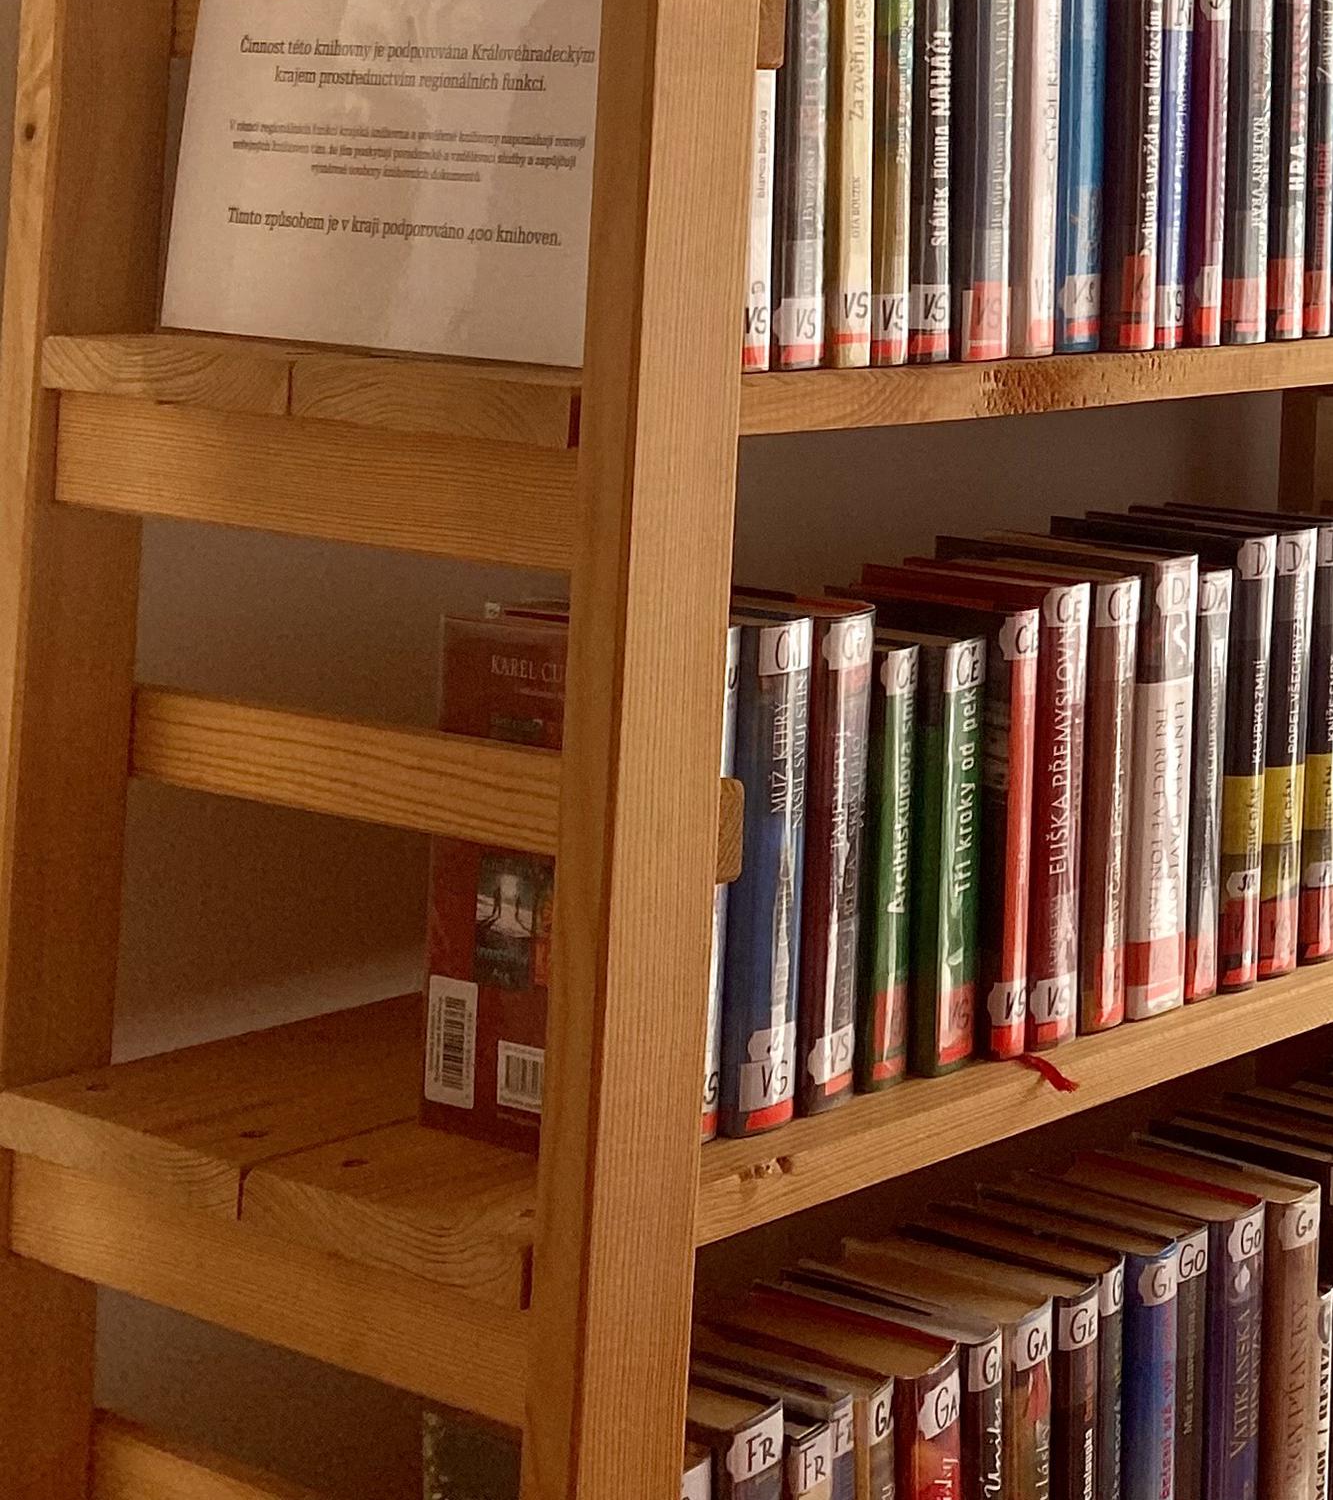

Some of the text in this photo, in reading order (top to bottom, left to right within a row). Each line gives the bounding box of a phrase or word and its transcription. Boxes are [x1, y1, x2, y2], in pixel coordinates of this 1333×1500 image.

[240, 34, 596, 67] Činnost této knihovny je podporována Královéhradeckým
[856, 24, 868, 47] na
[274, 66, 546, 92] krajem prostřednictvím regionálních funkcí.
[849, 47, 867, 94] zvěří
[228, 207, 562, 246] Tímto způsobem je v kraji podporováno 400 knihoven.
[960, 742, 976, 773] od
[887, 736, 913, 915] Arcibiskupova
[956, 783, 976, 853] kroky
[1046, 792, 1070, 875] ELIŠKA
[746, 1431, 776, 1474] FR
[802, 1445, 827, 1491] FR
